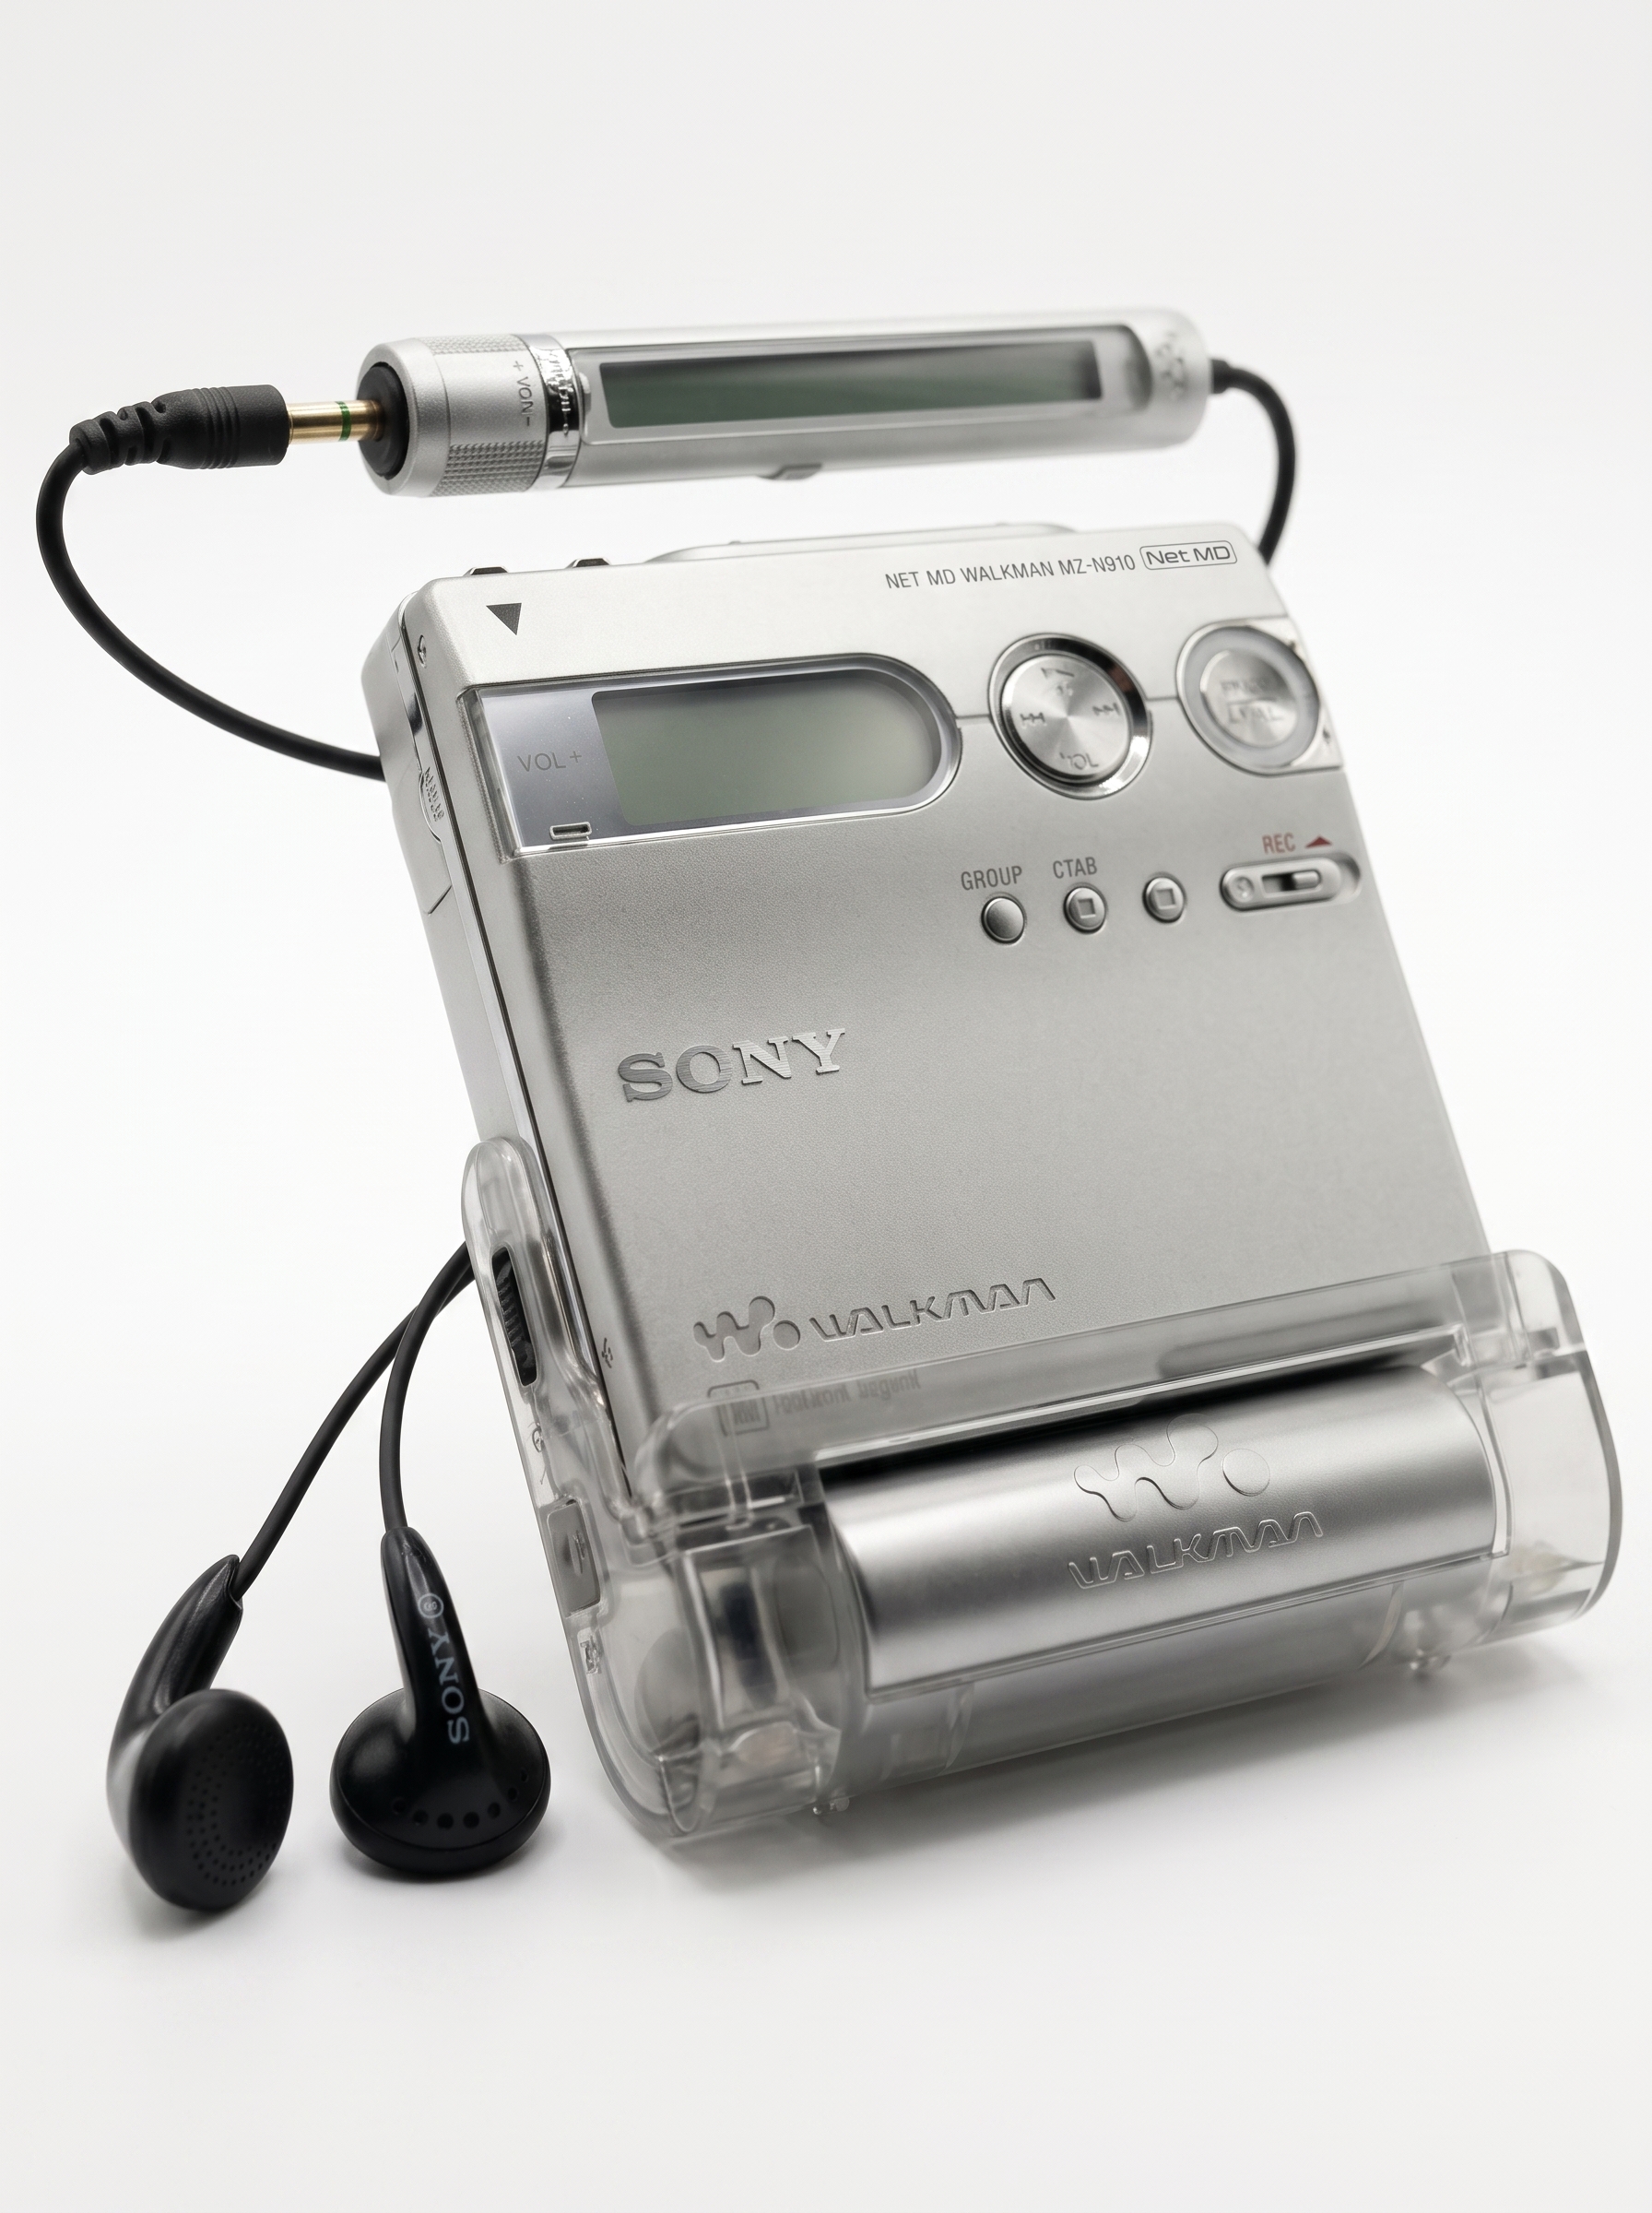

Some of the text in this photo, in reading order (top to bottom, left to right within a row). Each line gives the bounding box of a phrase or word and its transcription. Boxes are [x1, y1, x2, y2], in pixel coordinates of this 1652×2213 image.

[885, 554, 1136, 589] NET MD WALKMAN MZ-N910
[1145, 546, 1231, 565] Net MD
[1262, 833, 1296, 854] REC
[960, 865, 1023, 892] GROUP
[1052, 856, 1098, 880] CTAB
[617, 1027, 846, 1103] SONY
[808, 1277, 1056, 1343] WALKMAN
[1068, 1510, 1324, 1590] WALKMAN
[427, 1627, 470, 1745] SONY
